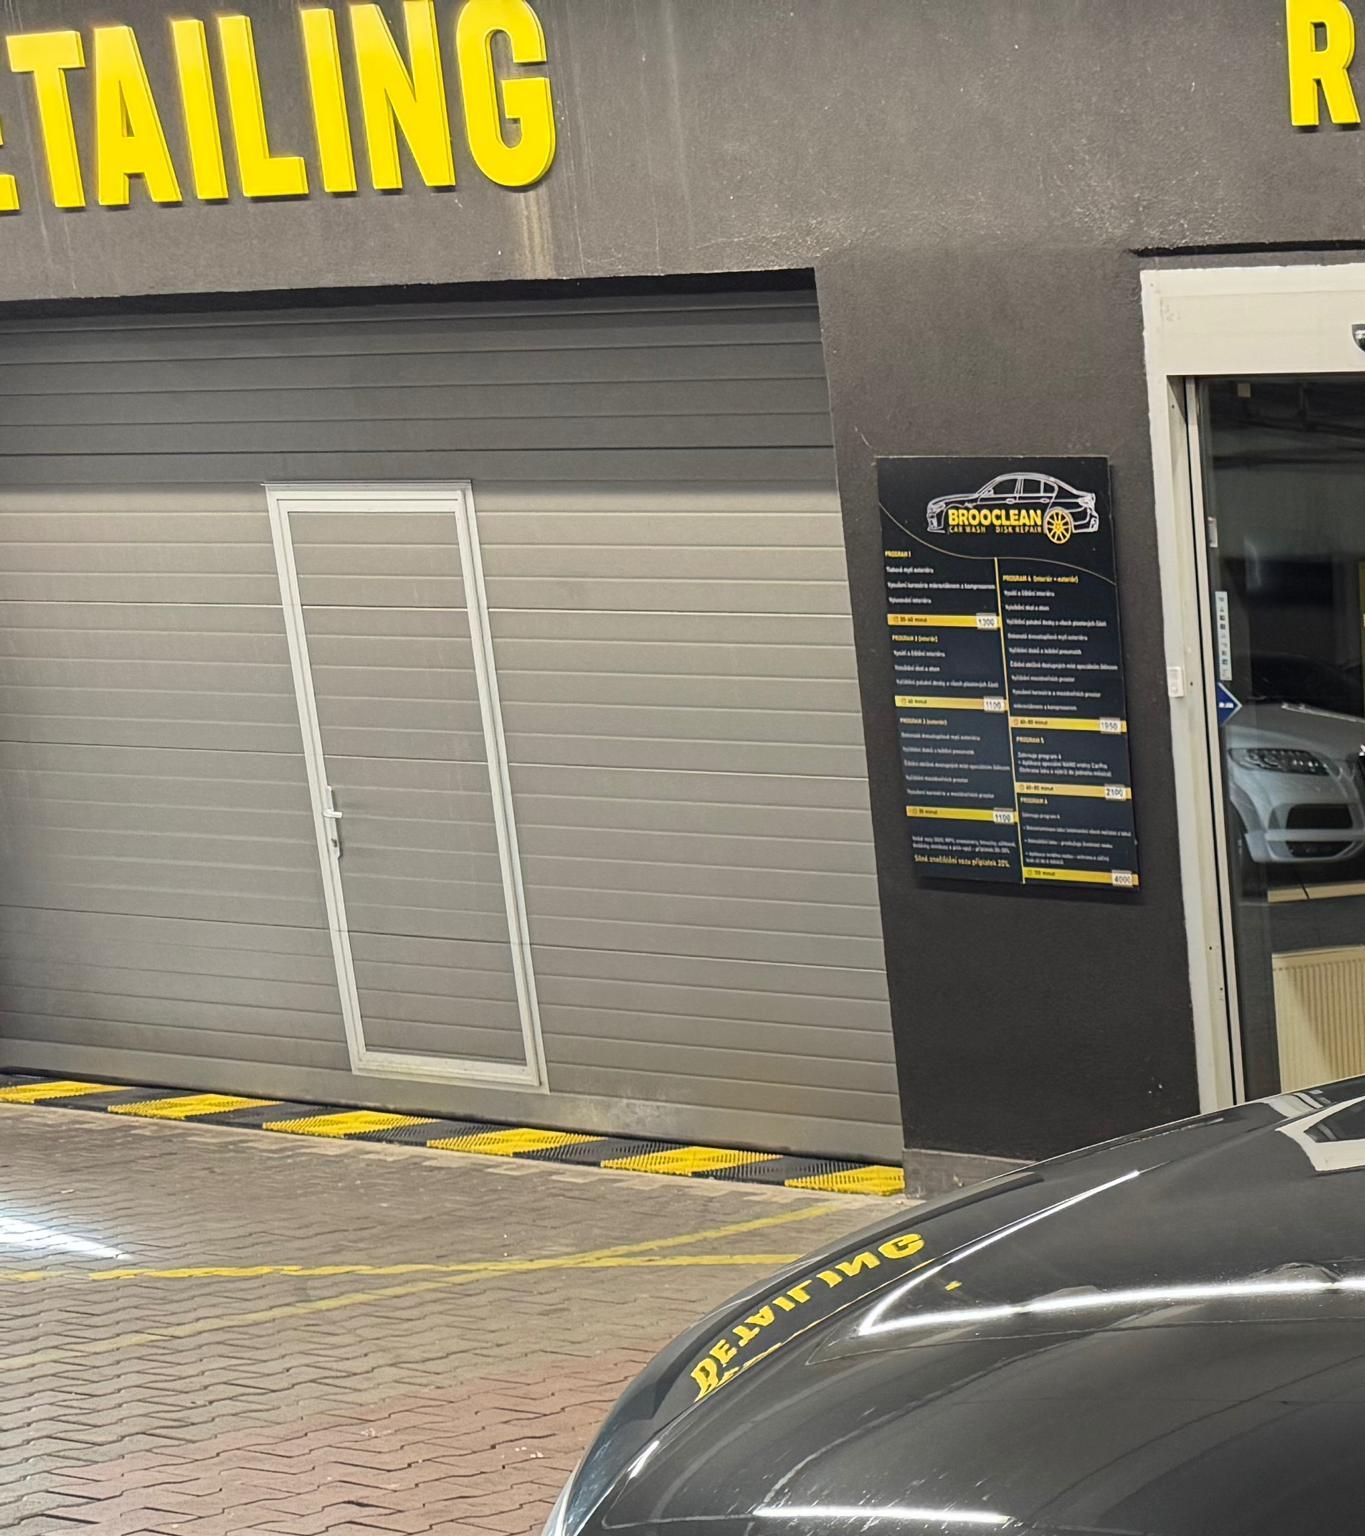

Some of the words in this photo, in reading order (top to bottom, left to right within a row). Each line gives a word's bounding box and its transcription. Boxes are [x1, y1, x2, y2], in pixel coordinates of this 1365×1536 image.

[0, 0, 556, 211] TAILING
[947, 508, 1043, 527] BROOCLEAN
[949, 525, 964, 533] CAR
[966, 525, 987, 533] WASH
[995, 526, 1014, 534] DISK
[1016, 526, 1043, 534] REPAIR
